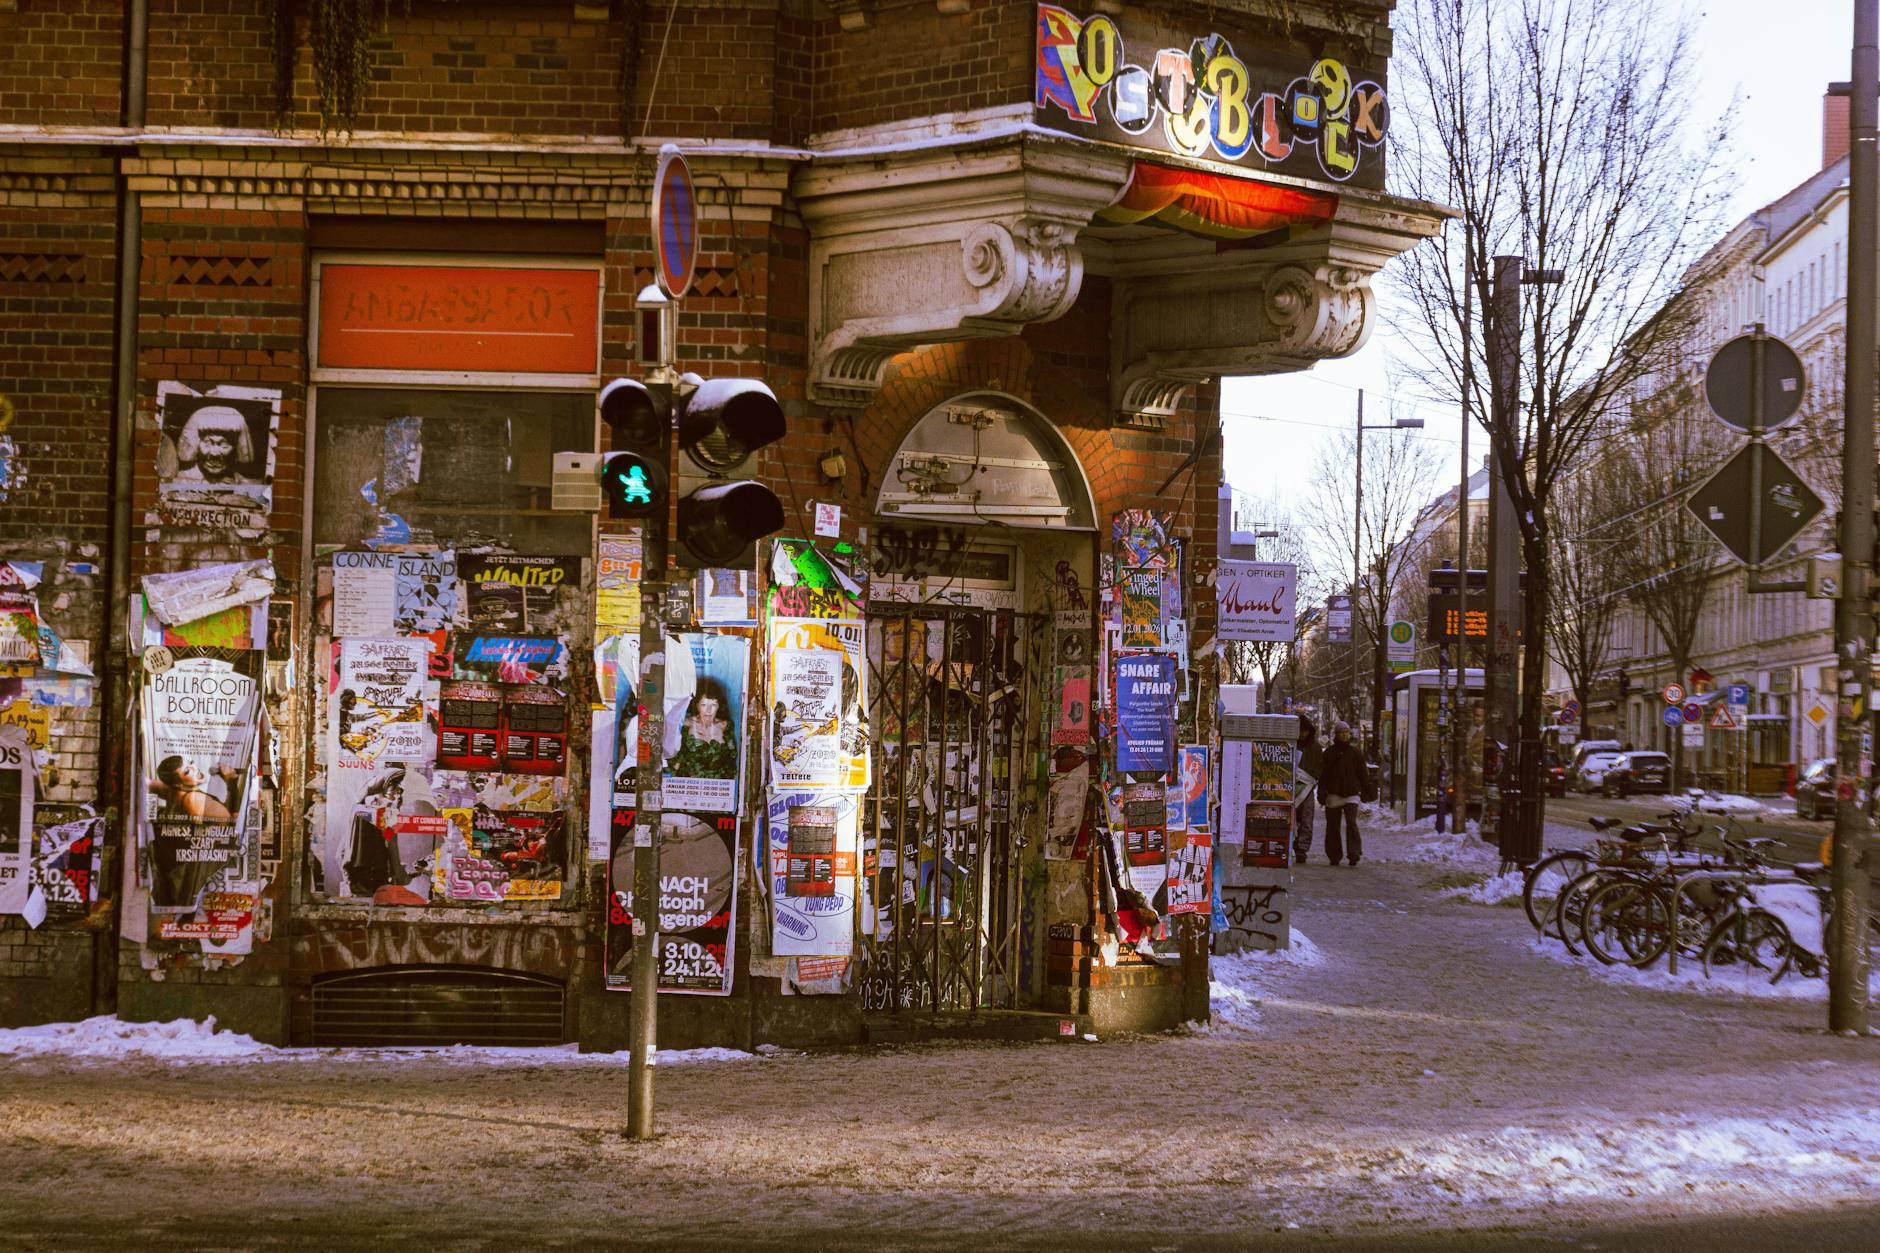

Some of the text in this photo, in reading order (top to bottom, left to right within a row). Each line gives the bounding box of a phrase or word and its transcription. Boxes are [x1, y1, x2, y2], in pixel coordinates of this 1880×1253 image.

[336, 553, 395, 568] CONNE
[484, 556, 555, 565] JETZT MITMACHEN
[398, 561, 456, 577] ISLAND
[474, 566, 565, 587] WANTED
[1246, 569, 1286, 578] OPTIKER
[1122, 568, 1160, 587] Winged
[1130, 581, 1160, 596] Wheel
[1221, 579, 1285, 615] Maul
[1123, 623, 1161, 634] 12.01.2026
[1119, 663, 1160, 678] SNARE
[155, 673, 251, 697] BALLROOM
[1131, 681, 1172, 695] AFFAIR
[1732, 687, 1744, 703] P
[168, 696, 237, 716] BOHEME
[1259, 751, 1294, 763] Wheel
[338, 760, 376, 771] SUUNS
[160, 825, 192, 837] AGNESE
[190, 837, 216, 850] SZARY
[198, 850, 228, 862] BRASKO
[803, 896, 845, 912] YUNG PEPP
[182, 923, 211, 932] OKT
[776, 911, 809, 937] WARNING
